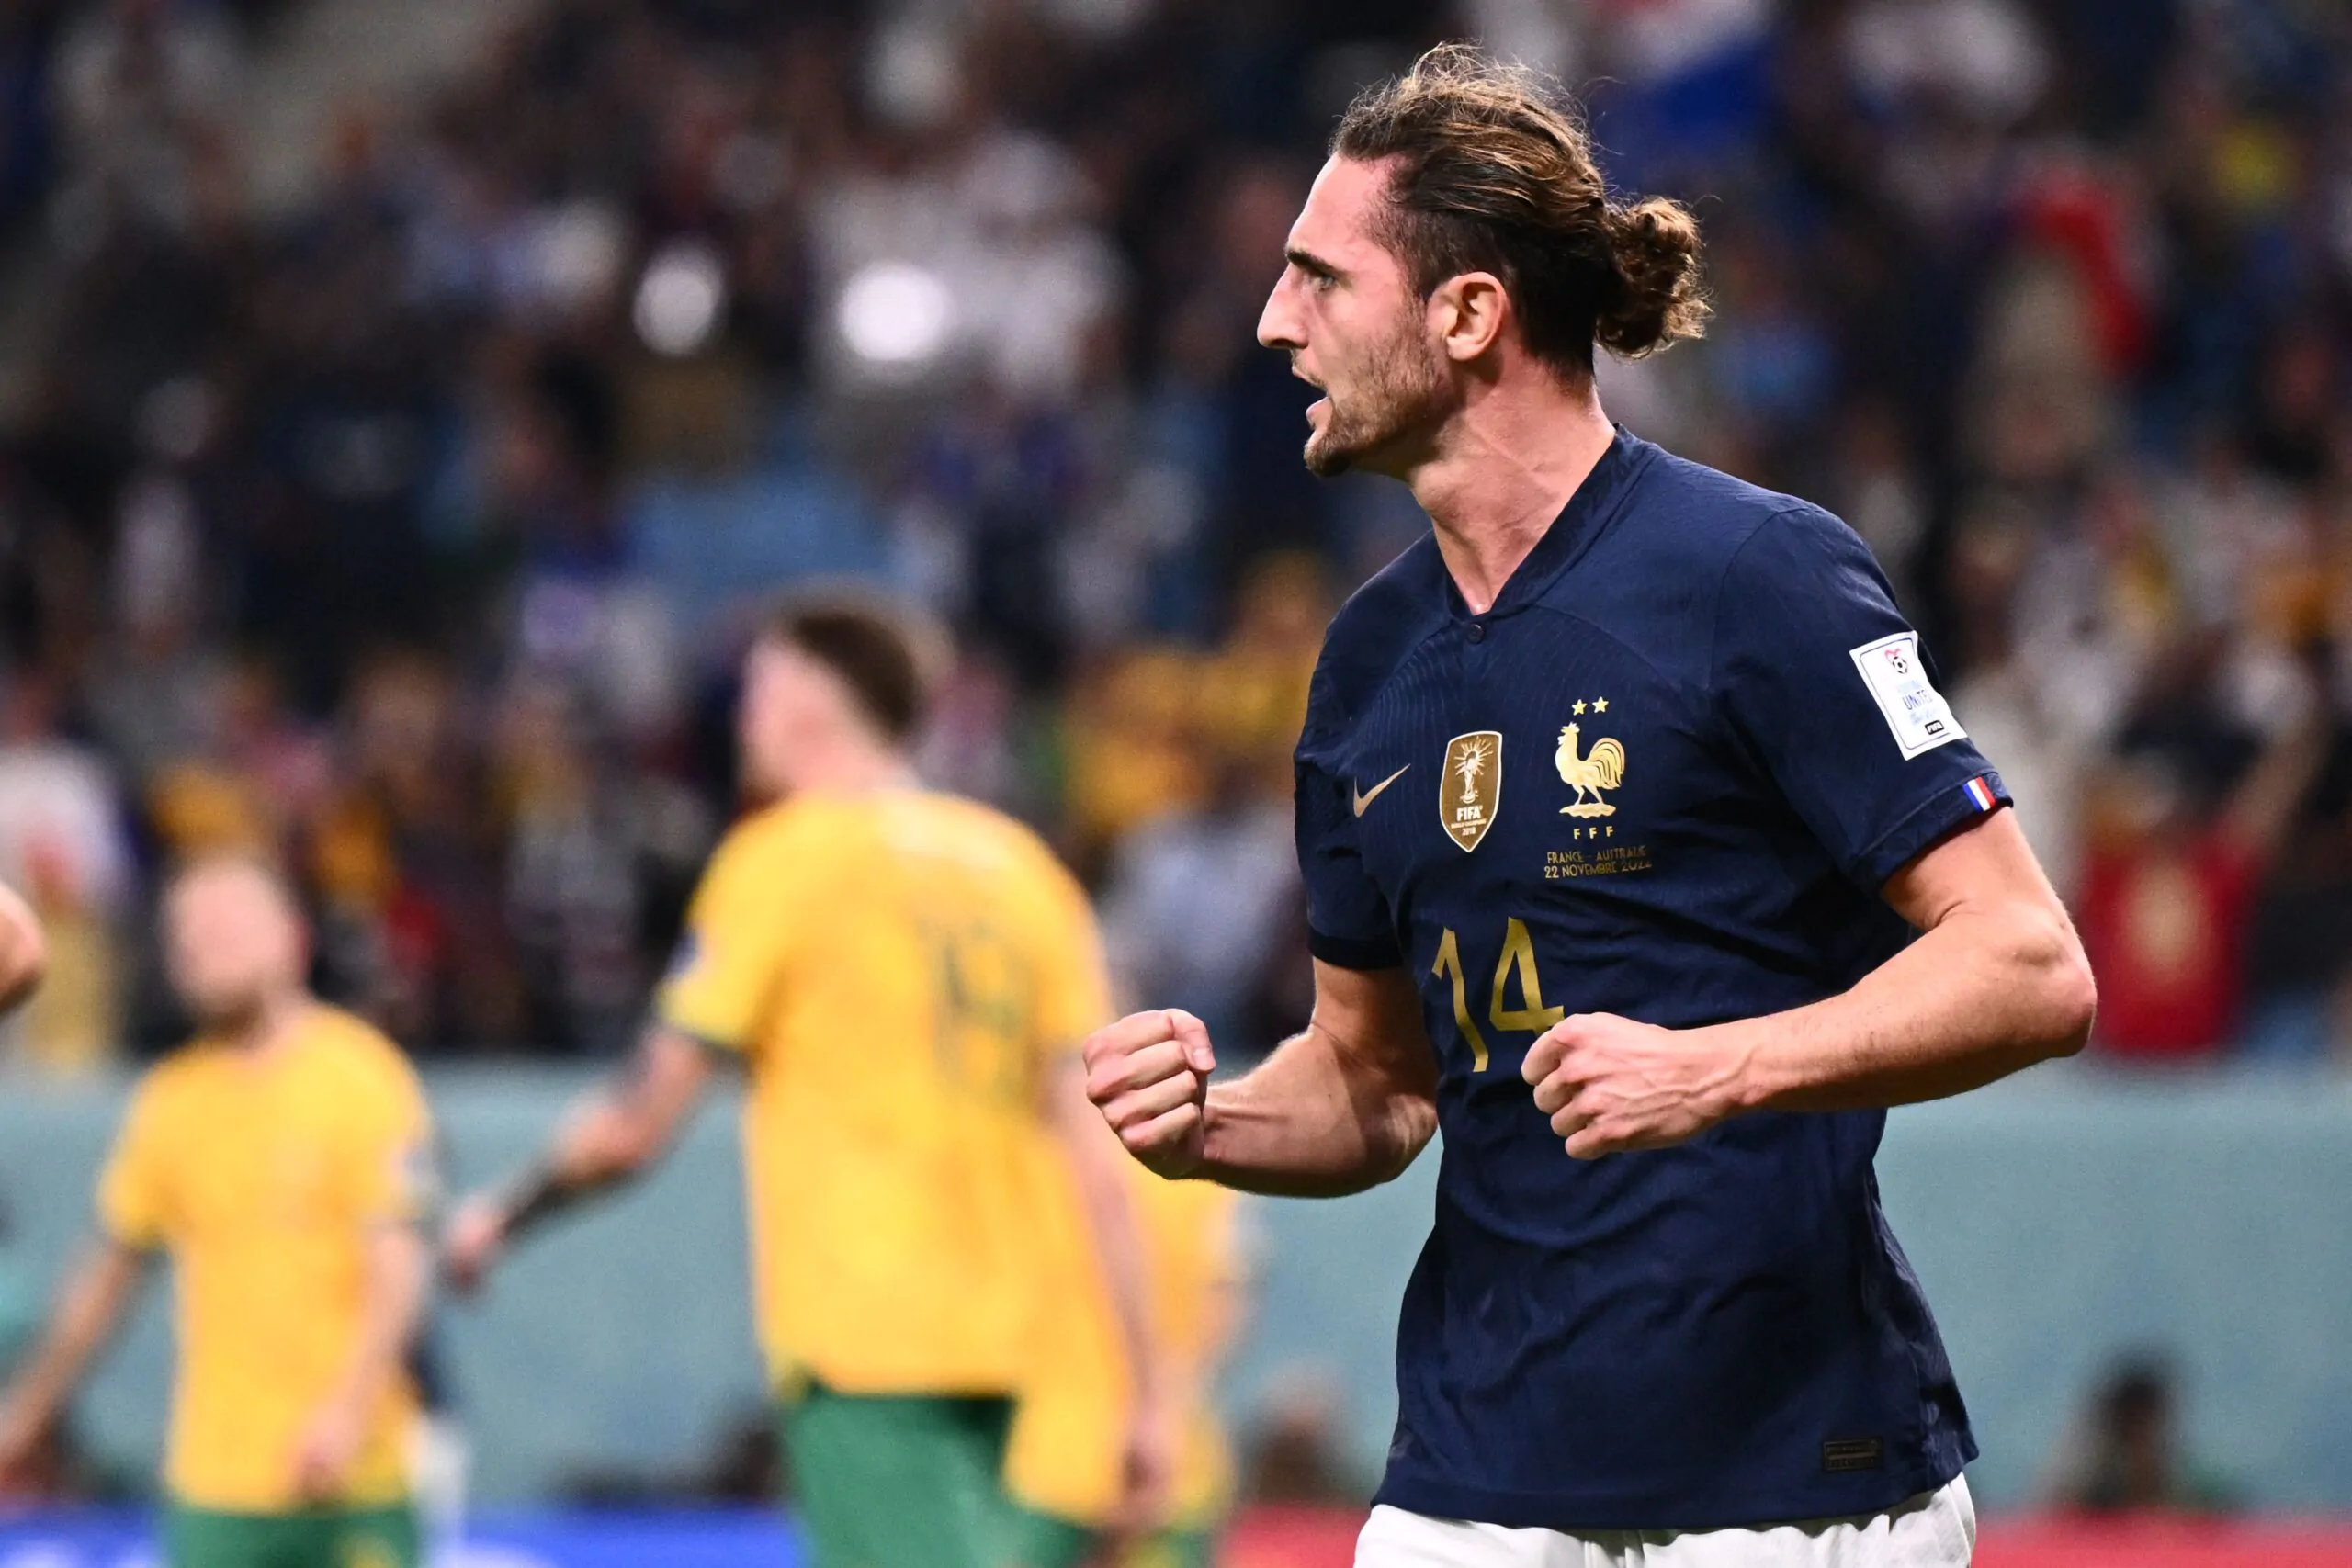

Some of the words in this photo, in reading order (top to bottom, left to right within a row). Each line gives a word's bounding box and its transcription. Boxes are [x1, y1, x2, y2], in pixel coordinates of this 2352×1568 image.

[1456, 806, 1482, 822] FIFA
[1546, 851, 1584, 864] FRANCE
[1544, 865, 1560, 879] 22
[1562, 861, 1617, 878] NOVEMBRE
[1431, 917, 1565, 1073] 14
